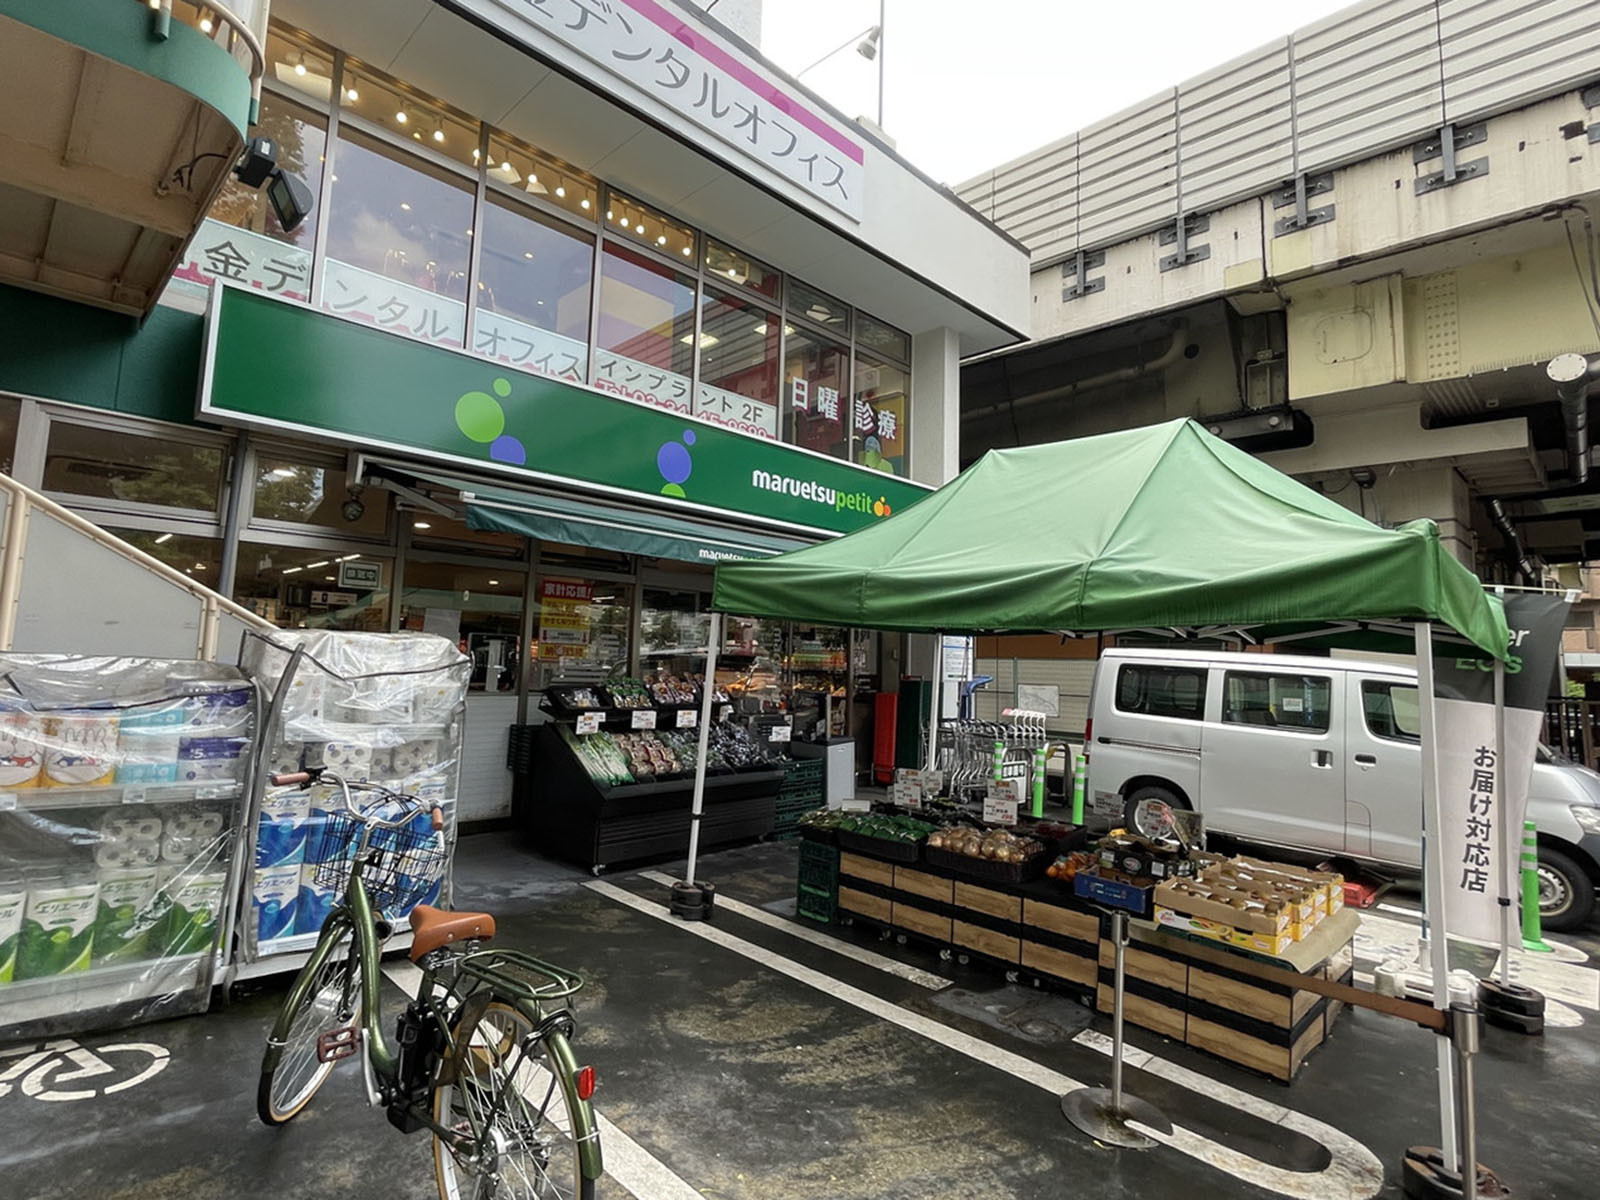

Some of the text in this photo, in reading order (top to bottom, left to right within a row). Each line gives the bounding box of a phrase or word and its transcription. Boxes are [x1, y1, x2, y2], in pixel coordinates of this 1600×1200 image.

[523, 0, 849, 200] デンタルオフィス
[601, 360, 732, 413] インプラント
[742, 403, 763, 422] 2F
[792, 376, 896, 440] 日曜診療
[1460, 745, 1497, 894] お届け対応店
[38, 900, 92, 915] エリエール
